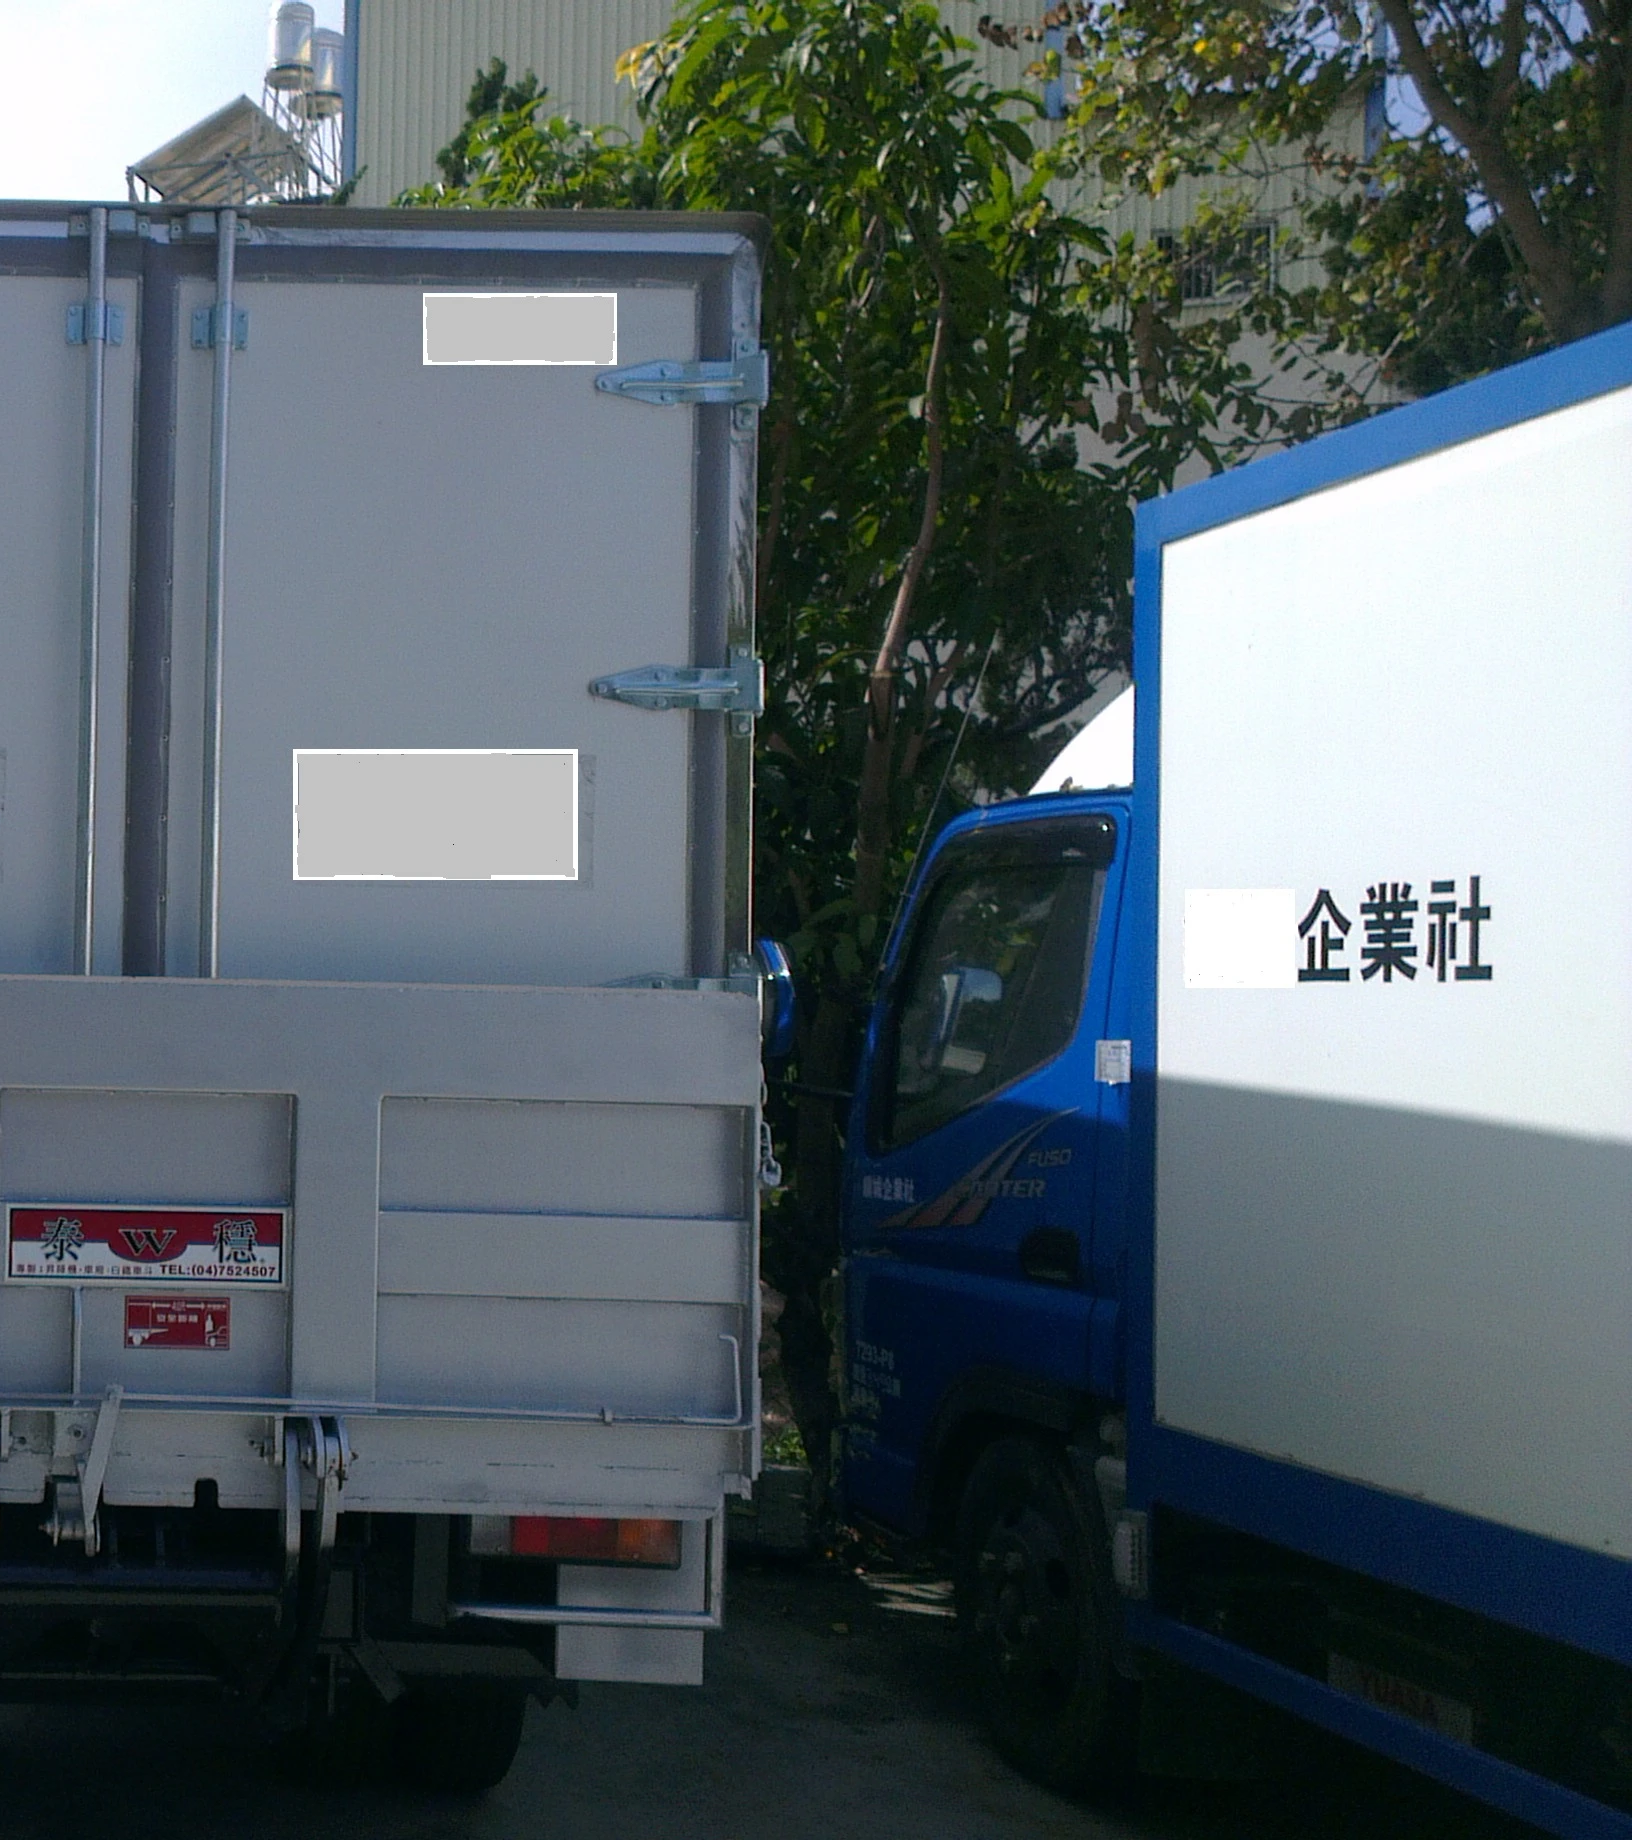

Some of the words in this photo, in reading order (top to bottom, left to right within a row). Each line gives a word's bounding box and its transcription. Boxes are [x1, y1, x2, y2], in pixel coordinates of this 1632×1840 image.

[1298, 875, 1493, 983] 企業社
[1027, 1148, 1072, 1168] FUSO
[159, 1263, 276, 1278] TEL:(04)7524507
